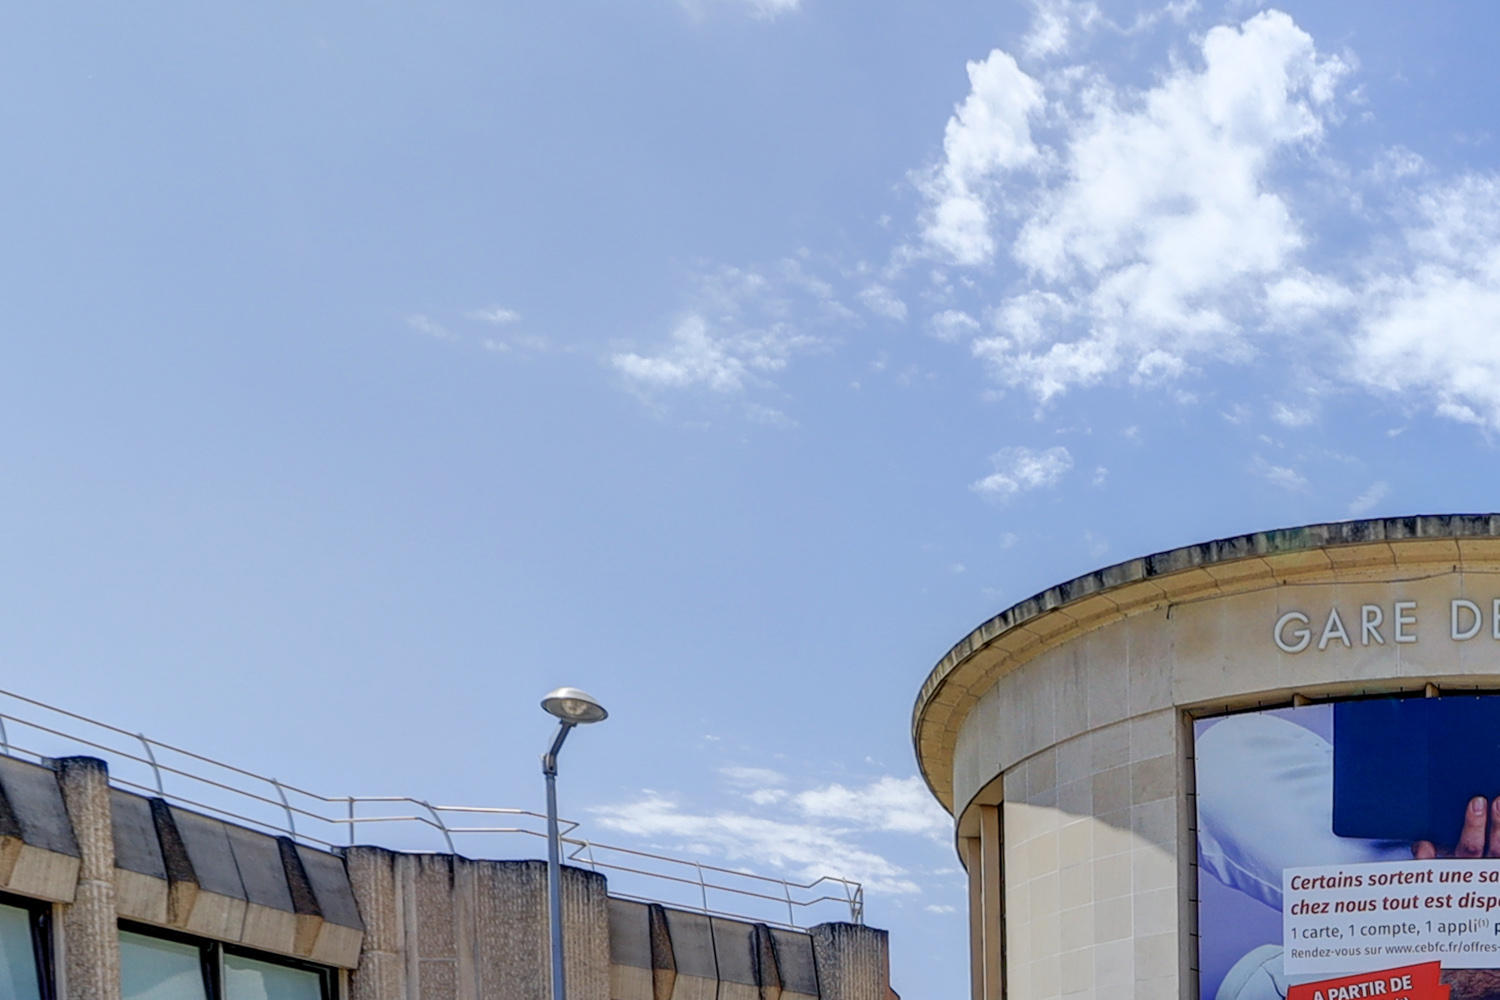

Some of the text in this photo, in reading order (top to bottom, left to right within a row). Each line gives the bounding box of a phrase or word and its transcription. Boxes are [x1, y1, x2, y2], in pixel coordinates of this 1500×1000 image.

[1273, 600, 1417, 654] GARE
[1290, 871, 1363, 890] Certains
[1368, 868, 1434, 886] sortent
[1439, 870, 1474, 883] une
[1290, 898, 1330, 916] chez
[1334, 899, 1378, 913] nous
[1382, 895, 1420, 911] tout
[1424, 894, 1453, 908] est
[1291, 928, 1297, 940] 1
[1302, 925, 1344, 941] carte,
[1348, 924, 1354, 936] 1
[1360, 922, 1421, 938] compte,
[1426, 920, 1432, 933] 1
[1290, 947, 1362, 959] Rendez-vous
[1364, 946, 1382, 956] sur
[1390, 975, 1413, 992] DE
